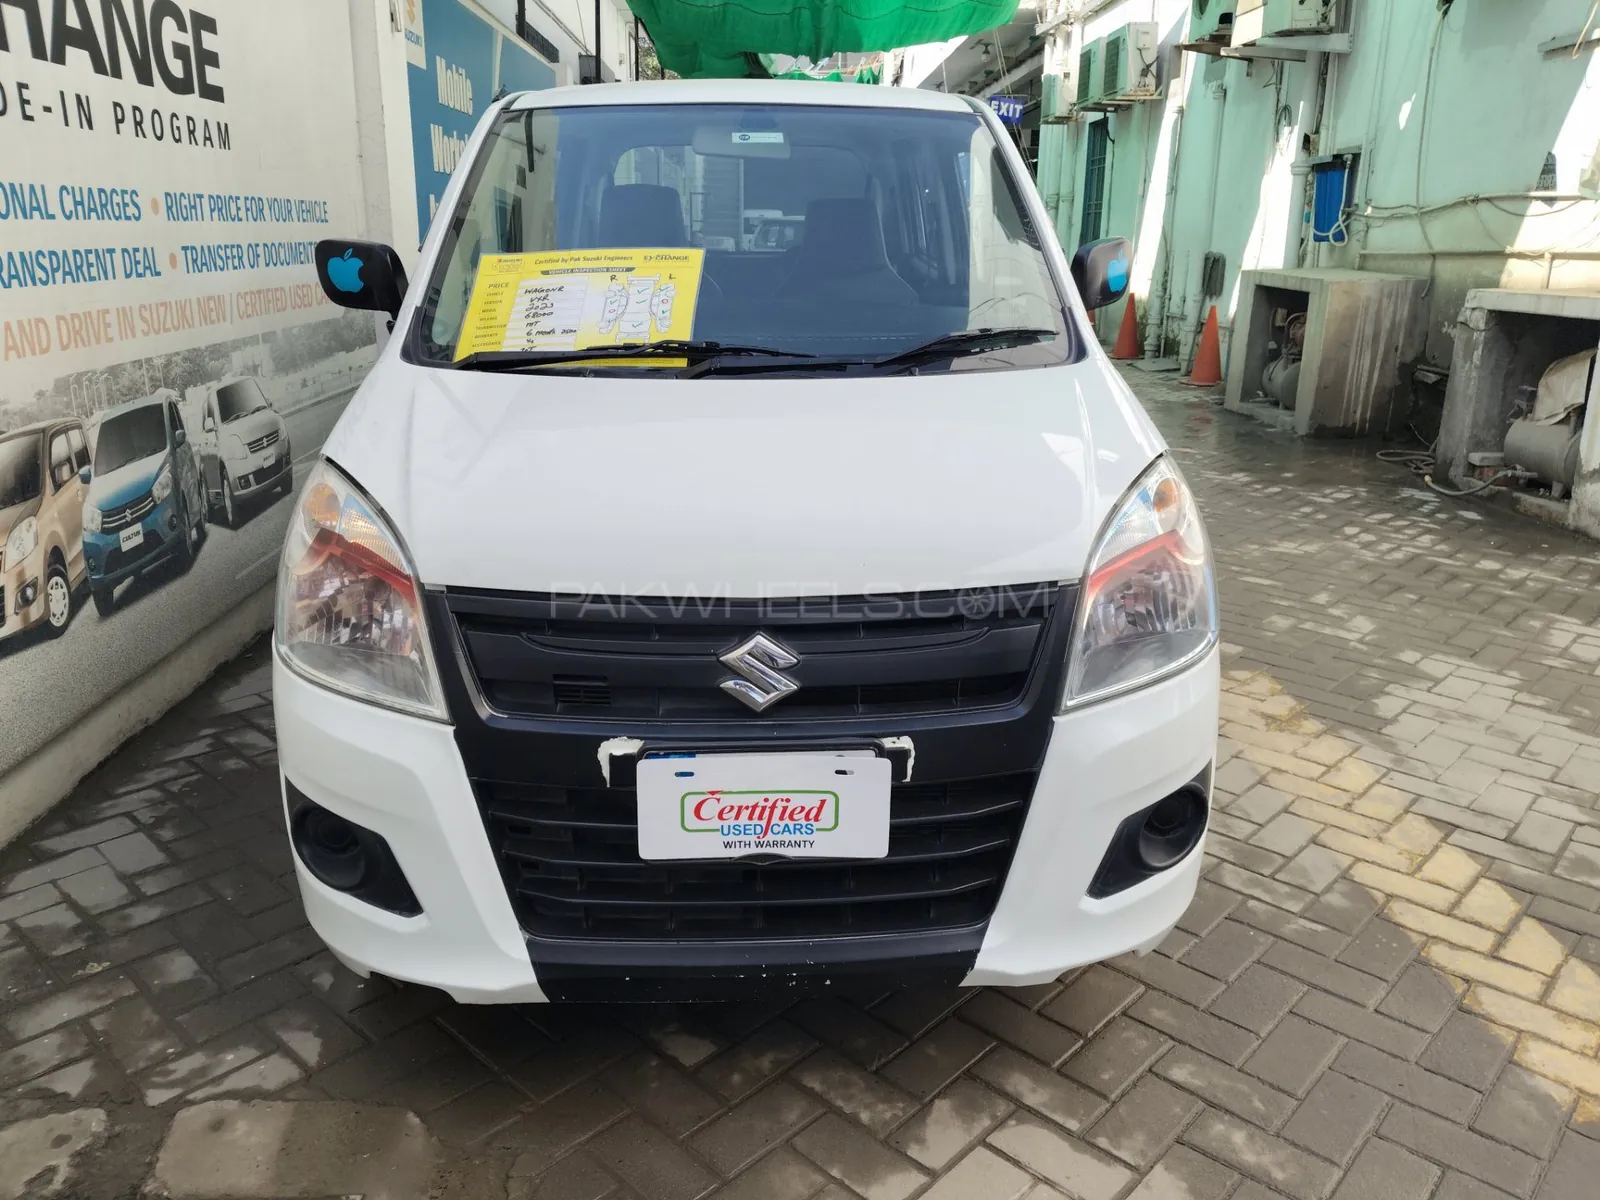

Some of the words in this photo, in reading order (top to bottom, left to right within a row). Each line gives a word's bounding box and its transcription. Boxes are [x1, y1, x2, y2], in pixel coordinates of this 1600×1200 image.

[990, 100, 1023, 118] EXIT
[112, 101, 231, 150] PROGRAM
[59, 184, 142, 222] CHARGES
[164, 191, 205, 222] RIGHT
[208, 194, 243, 222] PRICE
[245, 196, 266, 222] FOR
[266, 198, 293, 223] YOUR
[294, 199, 329, 223] VEHICLE
[121, 247, 161, 279] DEAL
[181, 243, 246, 274] TRANSFER
[247, 243, 261, 269] OF
[604, 254, 633, 262] Engineers
[610, 274, 618, 282] R
[4, 317, 52, 361] AND
[55, 308, 113, 352] DRIVE
[116, 306, 137, 341] IN
[139, 298, 196, 337] SUZUKI
[196, 294, 227, 327] NEW
[236, 286, 288, 320] CERTIFIED
[289, 283, 313, 311] USED
[315, 281, 332, 307] CA
[121, 530, 141, 543] CULTUS
[693, 796, 827, 839] Certified
[720, 824, 764, 836] USED
[770, 823, 815, 836] CARS
[723, 841, 752, 849] WITH
[754, 839, 816, 849] WARRANTY
